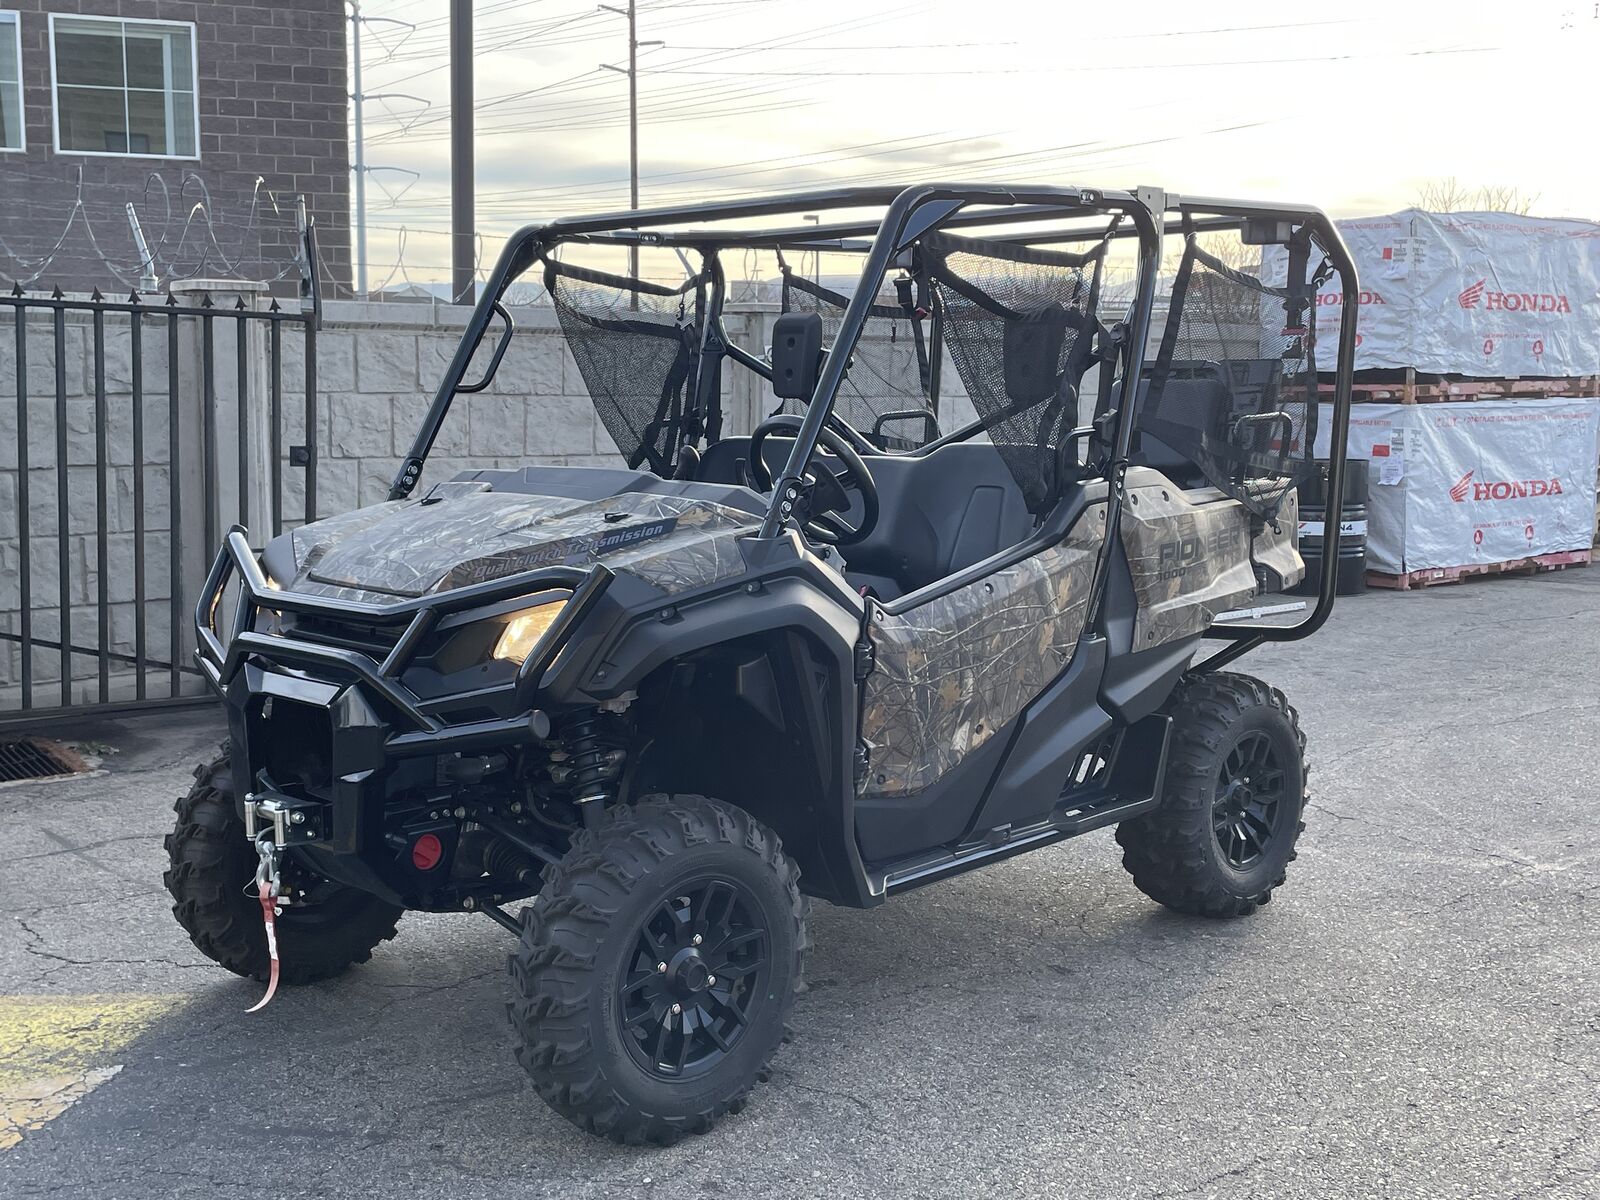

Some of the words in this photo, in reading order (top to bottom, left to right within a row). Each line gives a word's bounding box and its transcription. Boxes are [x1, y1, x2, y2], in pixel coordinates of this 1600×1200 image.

[1314, 292, 1386, 306] HODA
[1486, 291, 1572, 313] HONDA
[1473, 478, 1563, 501] HONDA
[473, 560, 511, 578] Dual
[514, 548, 562, 570] Clutch
[566, 524, 664, 554] Transmission
[1159, 526, 1241, 565] PIONEER
